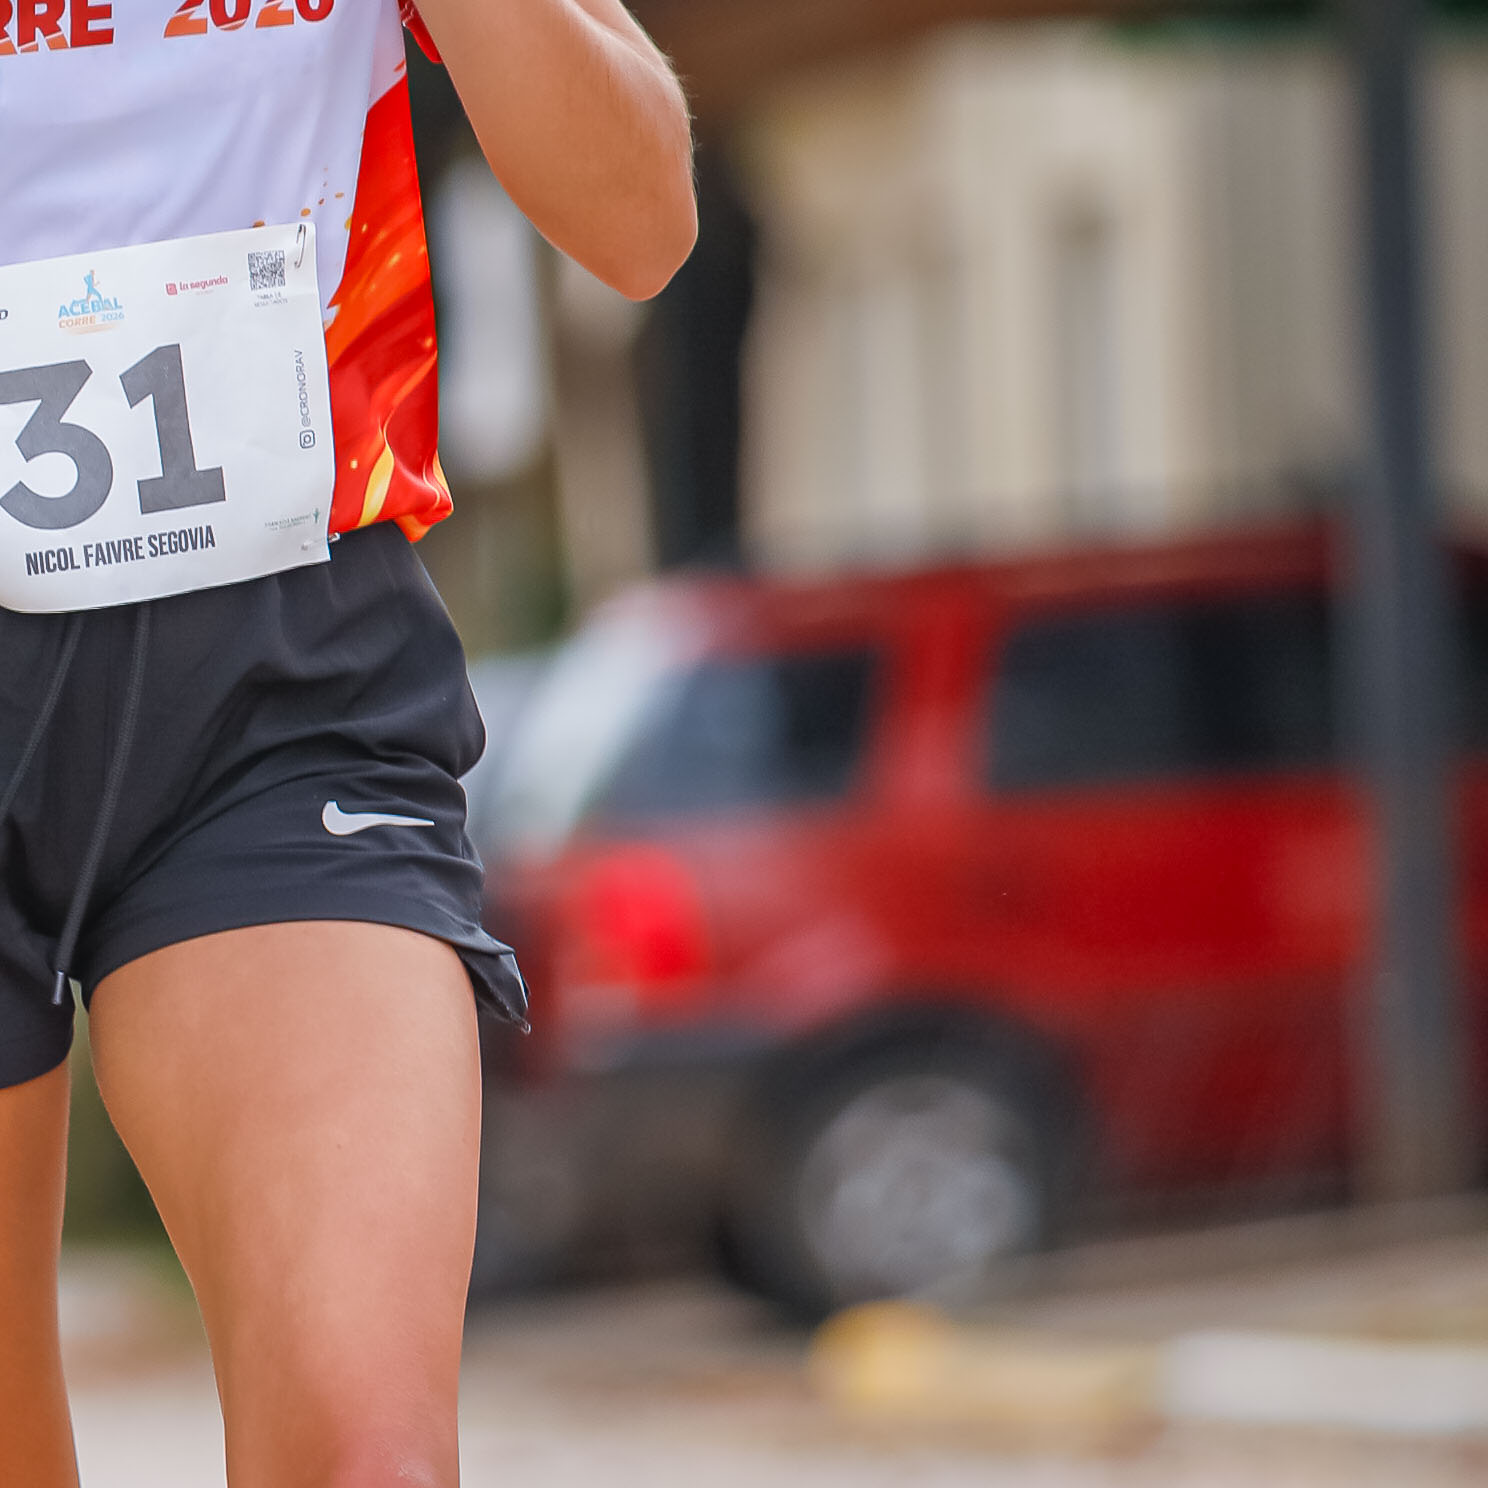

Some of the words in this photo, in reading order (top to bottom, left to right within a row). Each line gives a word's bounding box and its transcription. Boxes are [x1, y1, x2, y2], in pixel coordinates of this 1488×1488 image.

[190, 275, 229, 290] segunda
[58, 297, 123, 319] ACEBAL
[58, 315, 96, 329] CORRE
[101, 312, 125, 322] 2026
[294, 349, 312, 427] @CRONORAV
[25, 547, 81, 576] NICOL
[83, 536, 146, 568] FAIVRE
[147, 525, 216, 558] SEGOVIA
